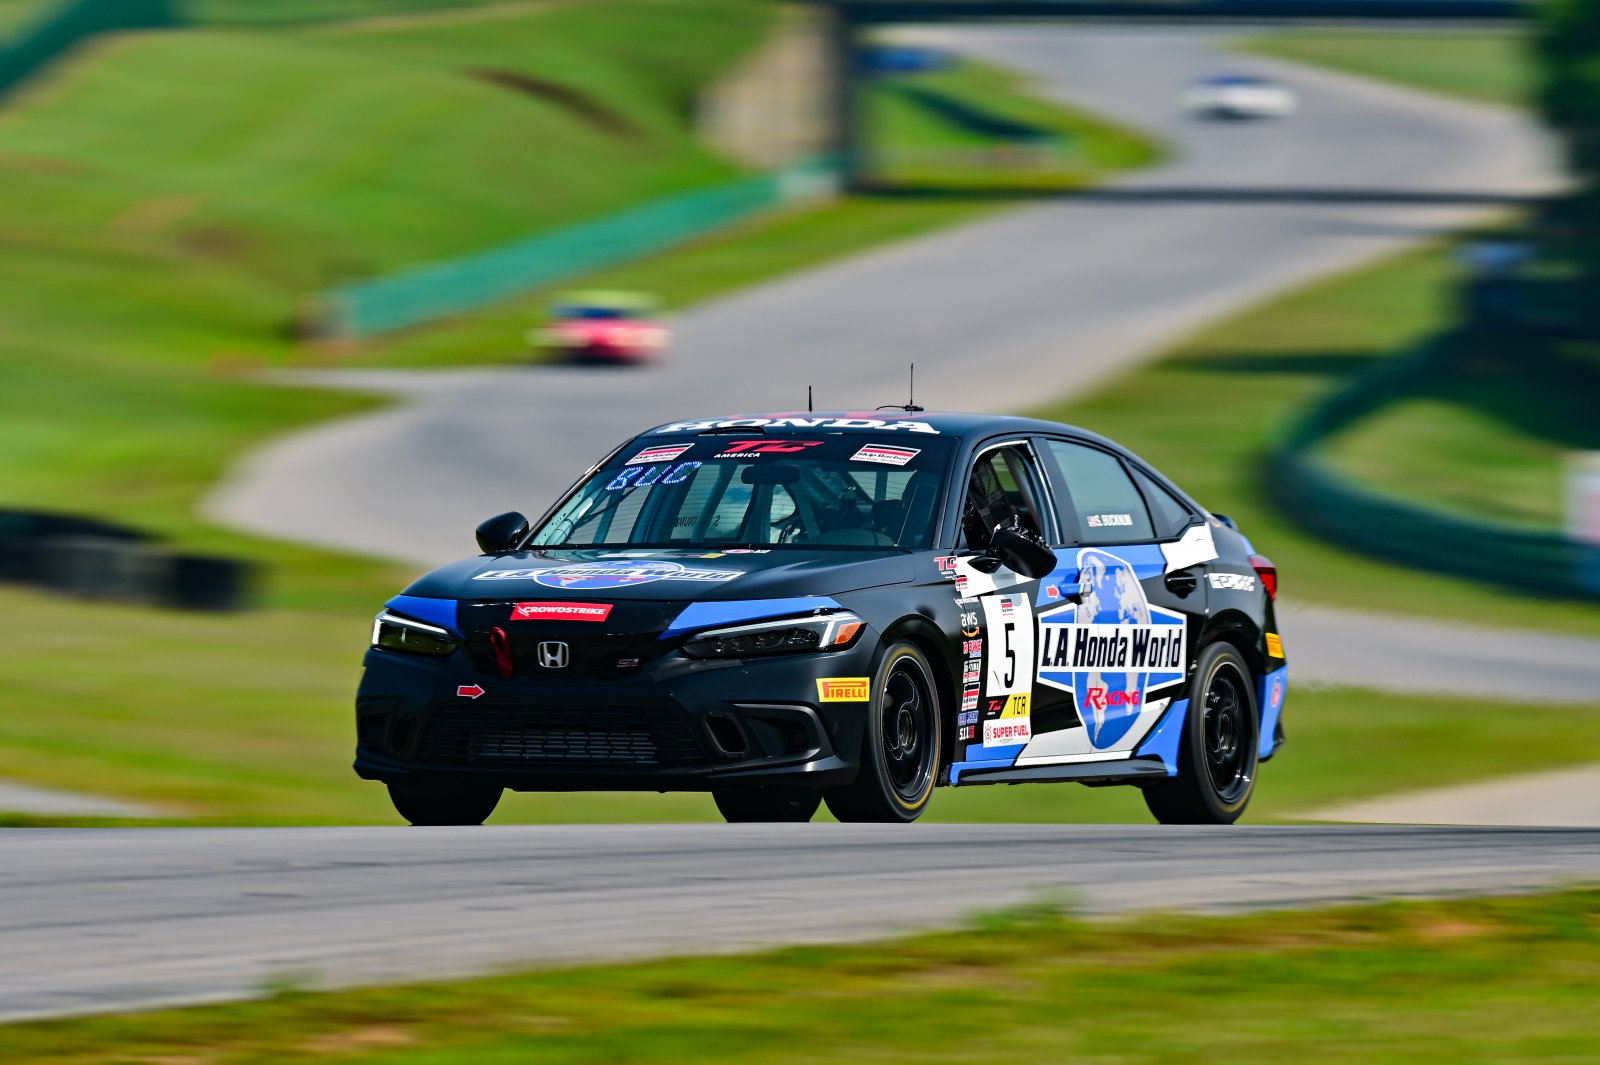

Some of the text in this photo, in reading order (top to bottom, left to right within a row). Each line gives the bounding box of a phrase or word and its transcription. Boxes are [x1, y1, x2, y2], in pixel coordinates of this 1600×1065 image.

[656, 418, 941, 434] HONDA
[519, 606, 606, 615] CROWDSTRIKE
[961, 612, 978, 627] aws
[1004, 622, 1016, 689] 5
[1042, 628, 1183, 667] L.A. Honda World
[822, 681, 867, 698] PIRELLI
[1084, 688, 1139, 710] RACING
[993, 724, 1029, 739] SUPER FUEL
